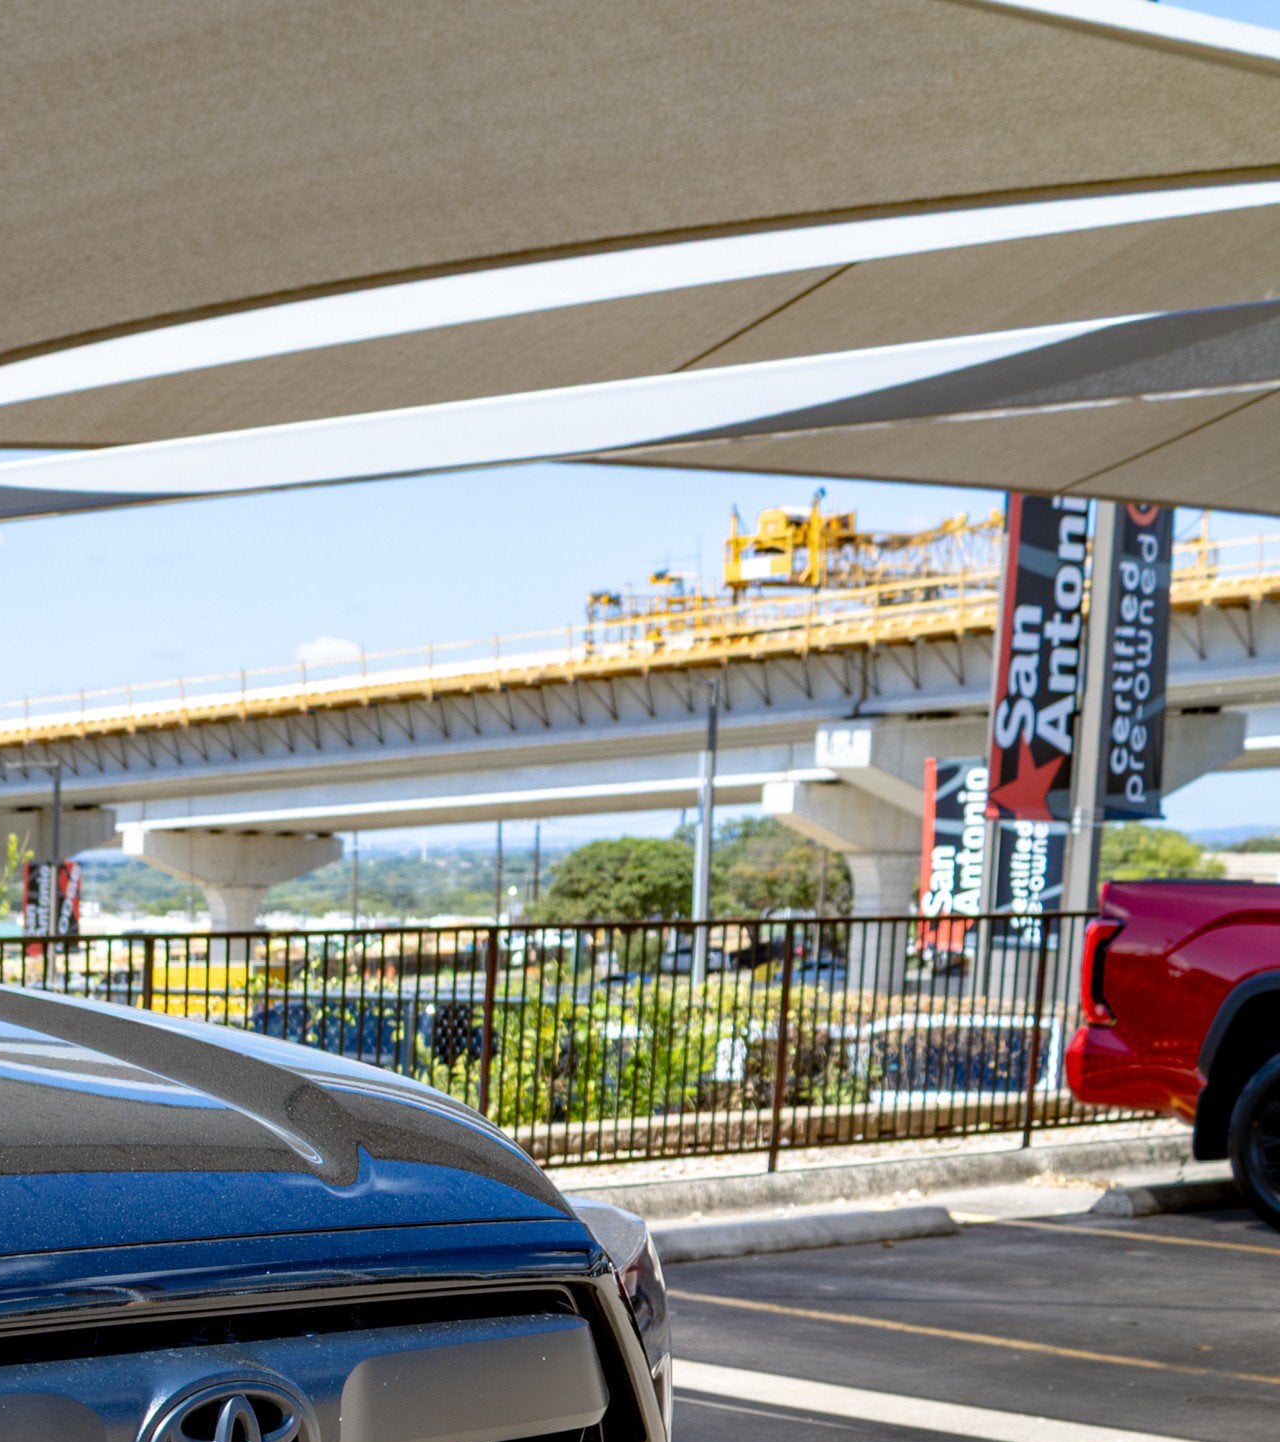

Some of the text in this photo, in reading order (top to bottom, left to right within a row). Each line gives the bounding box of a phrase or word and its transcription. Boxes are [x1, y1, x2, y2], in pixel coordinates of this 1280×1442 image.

[994, 602, 1043, 750] San
[1110, 561, 1140, 775] certified
[1126, 533, 1159, 802] pre-owned
[921, 845, 956, 917] San
[952, 766, 990, 916] Antonio
